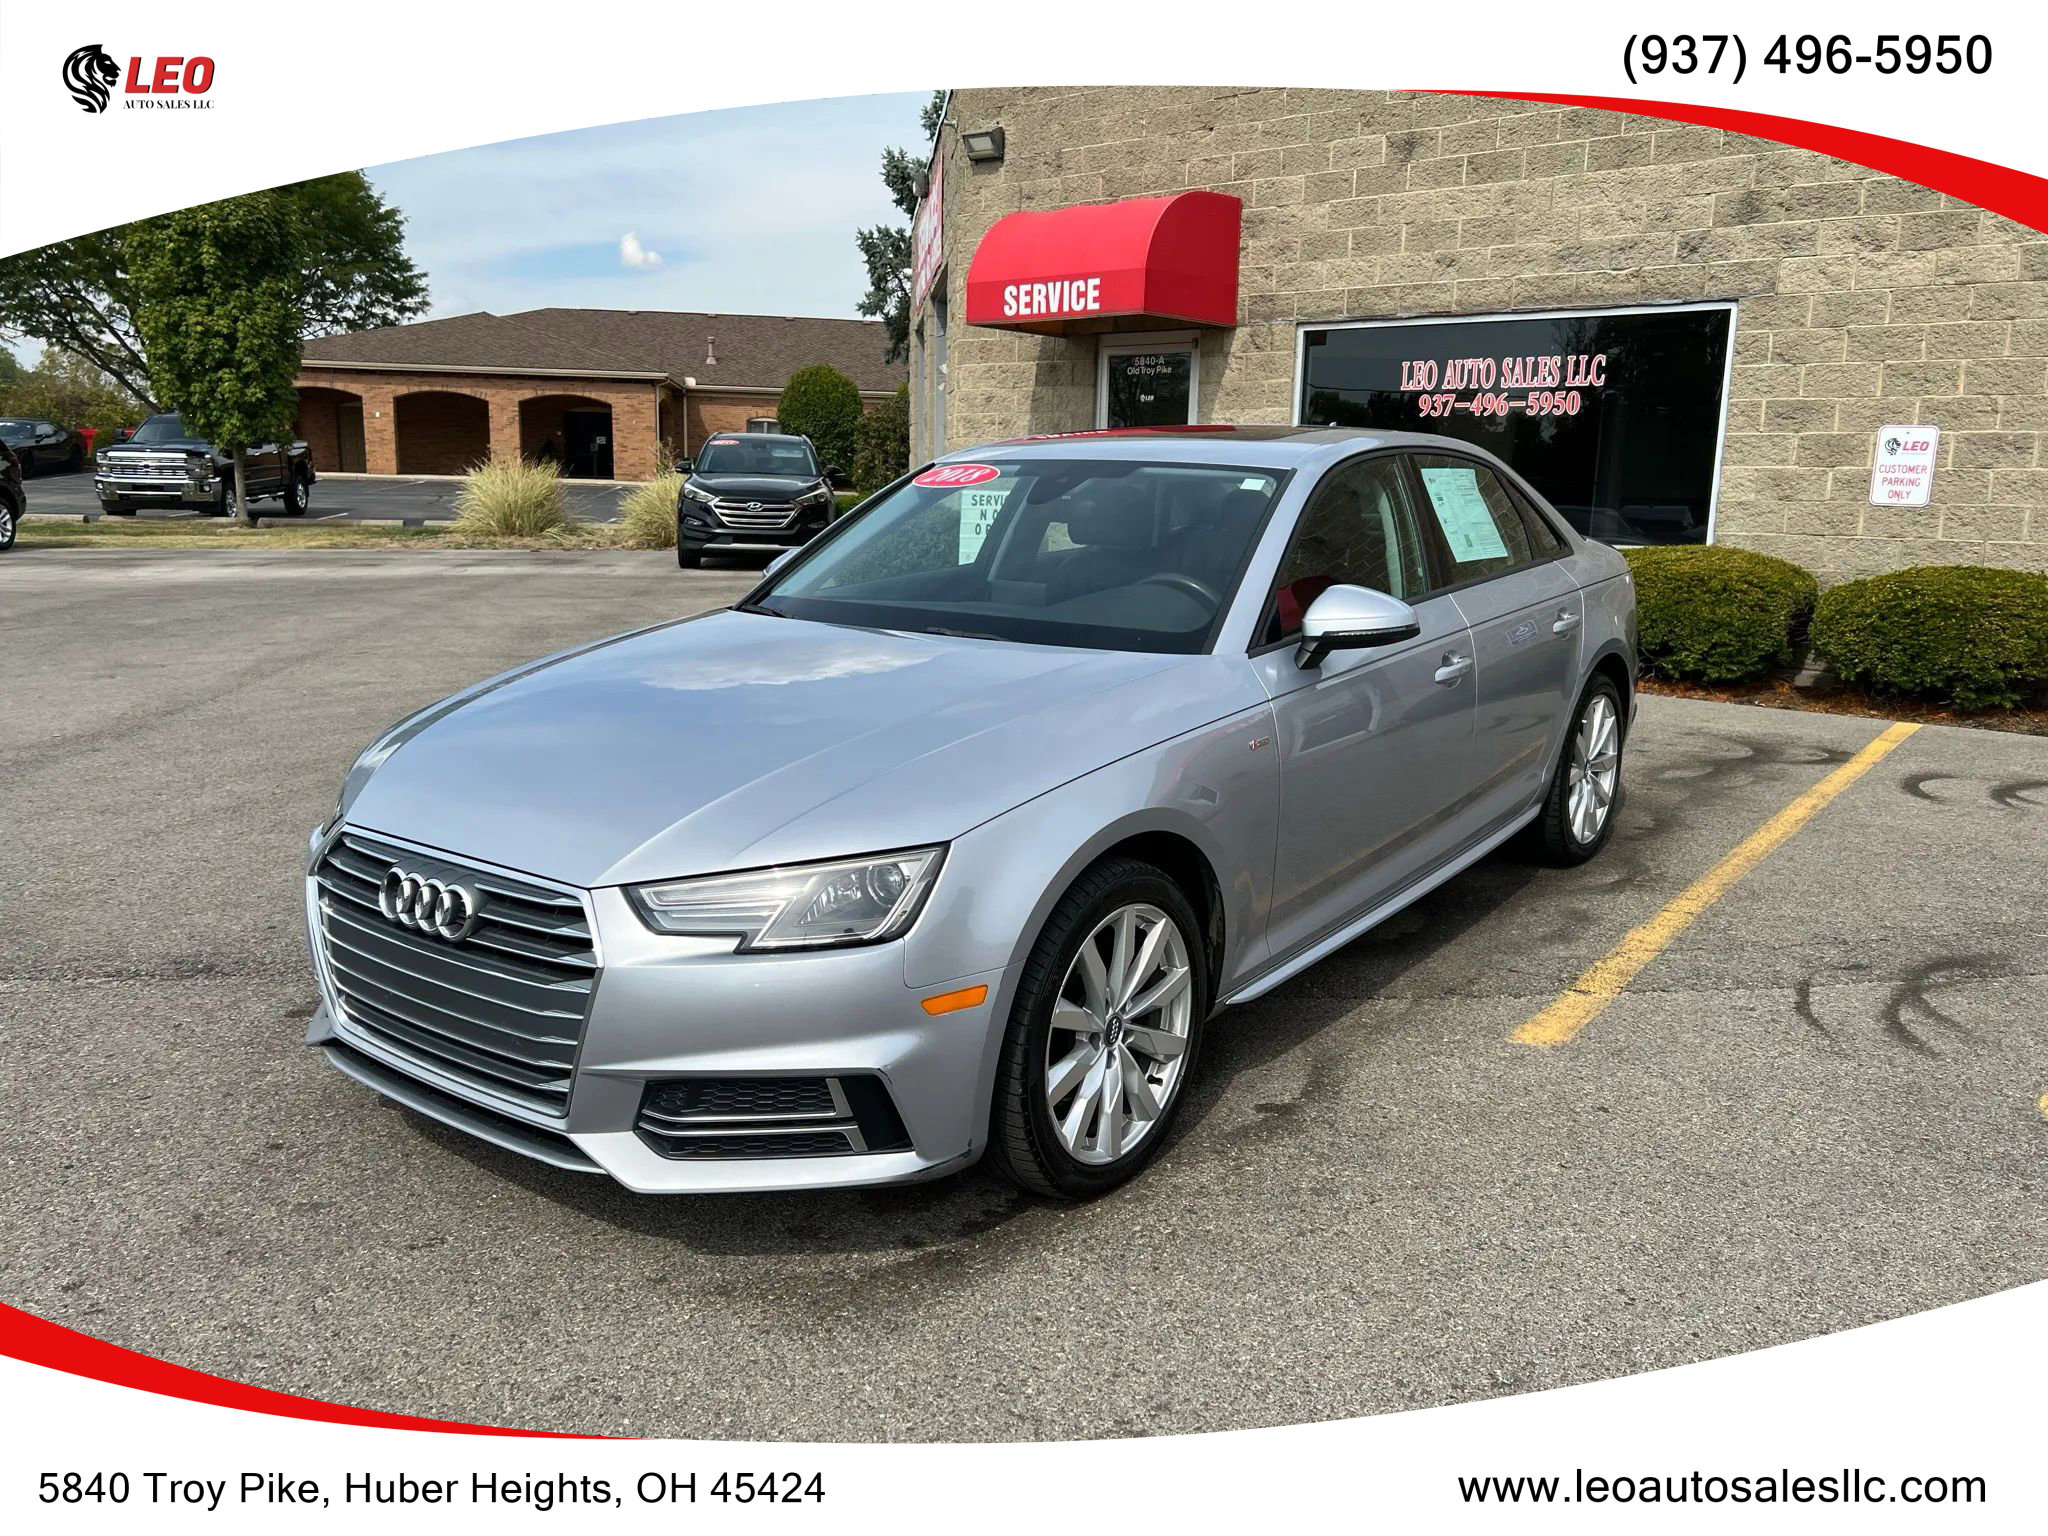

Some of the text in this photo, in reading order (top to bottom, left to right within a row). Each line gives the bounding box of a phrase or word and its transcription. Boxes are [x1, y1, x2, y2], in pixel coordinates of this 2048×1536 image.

[1003, 277, 1101, 317] SERVICE
[1134, 355, 1165, 366] 5840-A
[1127, 365, 1172, 376] Old Troy Pike
[1400, 353, 1606, 391] LEO AUTO SALES LLC
[1418, 390, 1582, 417] 937-496-5950
[1902, 441, 1930, 451] LEO
[1879, 464, 1928, 474] CUSTOMER
[921, 468, 990, 483] 2018
[1882, 477, 1921, 487] PARKING
[1888, 490, 1912, 499] ONLY
